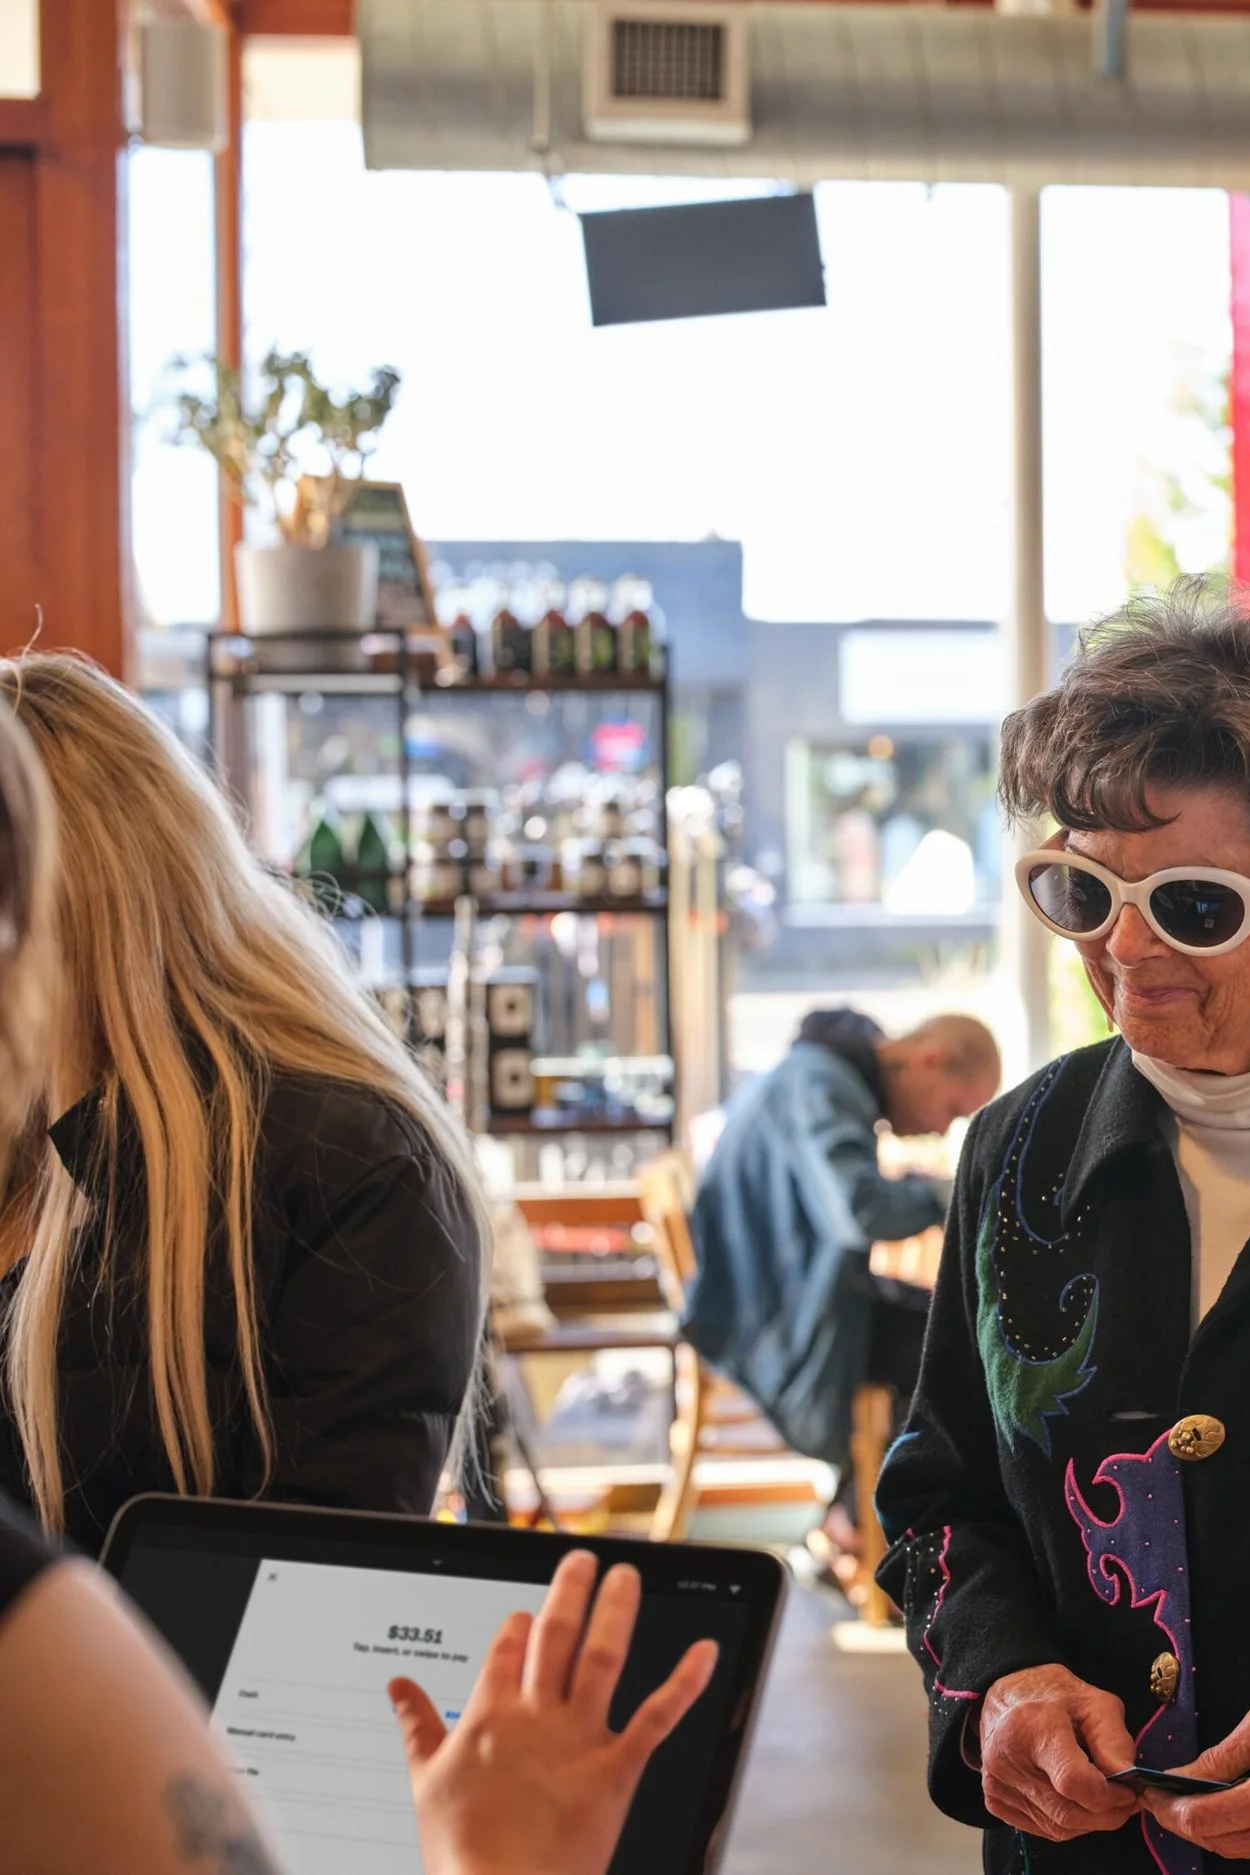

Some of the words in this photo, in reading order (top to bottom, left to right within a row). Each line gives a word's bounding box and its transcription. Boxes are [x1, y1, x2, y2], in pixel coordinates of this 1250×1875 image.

[387, 1624, 443, 1644] $33.51
[413, 1650, 439, 1659] swipe
[440, 1652, 451, 1660] to
[451, 1654, 469, 1664] pay
[226, 1726, 256, 1738] Manual
[257, 1730, 275, 1739] card
[275, 1733, 297, 1744] entry
